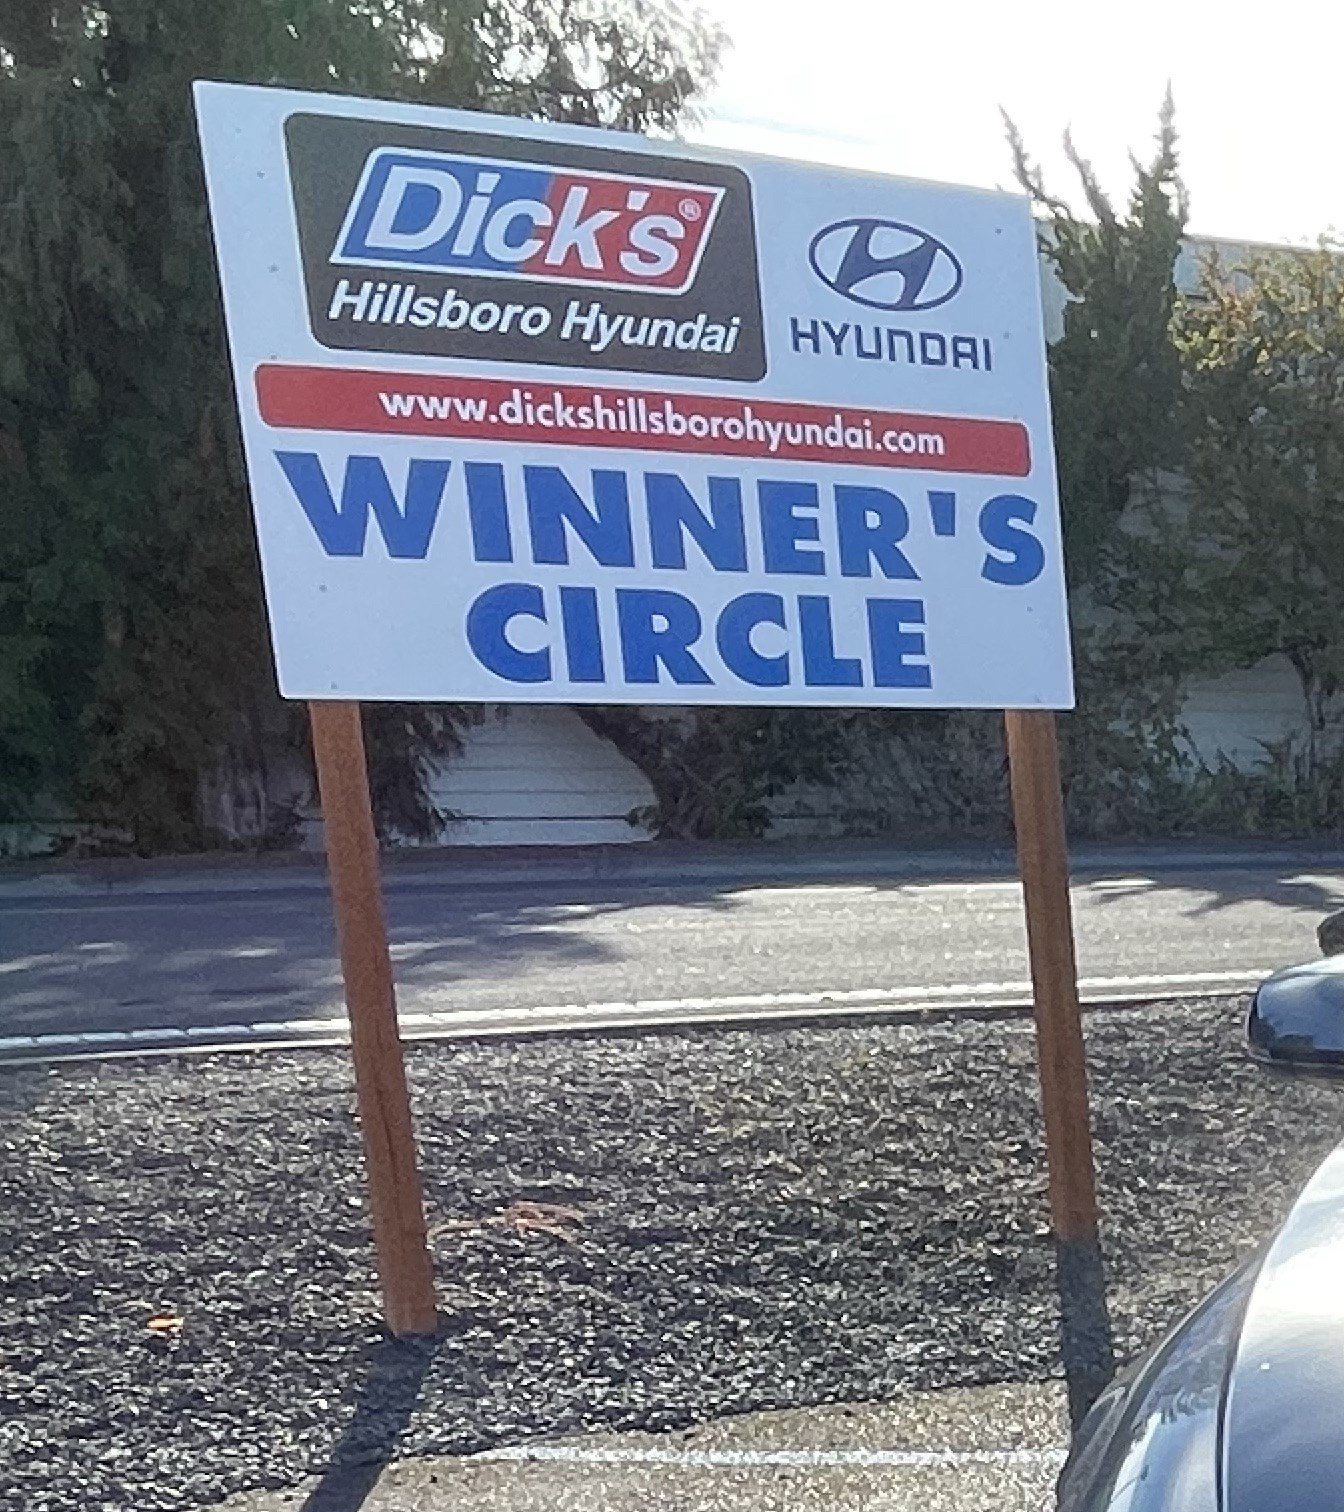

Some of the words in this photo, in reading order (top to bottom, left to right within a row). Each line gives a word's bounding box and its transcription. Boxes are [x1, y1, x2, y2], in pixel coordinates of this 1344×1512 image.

[364, 165, 686, 277] Dick's
[328, 280, 550, 336] Hillsboro
[560, 301, 742, 354] Hyundai
[790, 316, 993, 371] HYUNDAI
[379, 388, 945, 456] www.dickshillsborohyundai.com
[273, 450, 1045, 586] WINNER'S
[466, 583, 932, 688] CIRCLE
